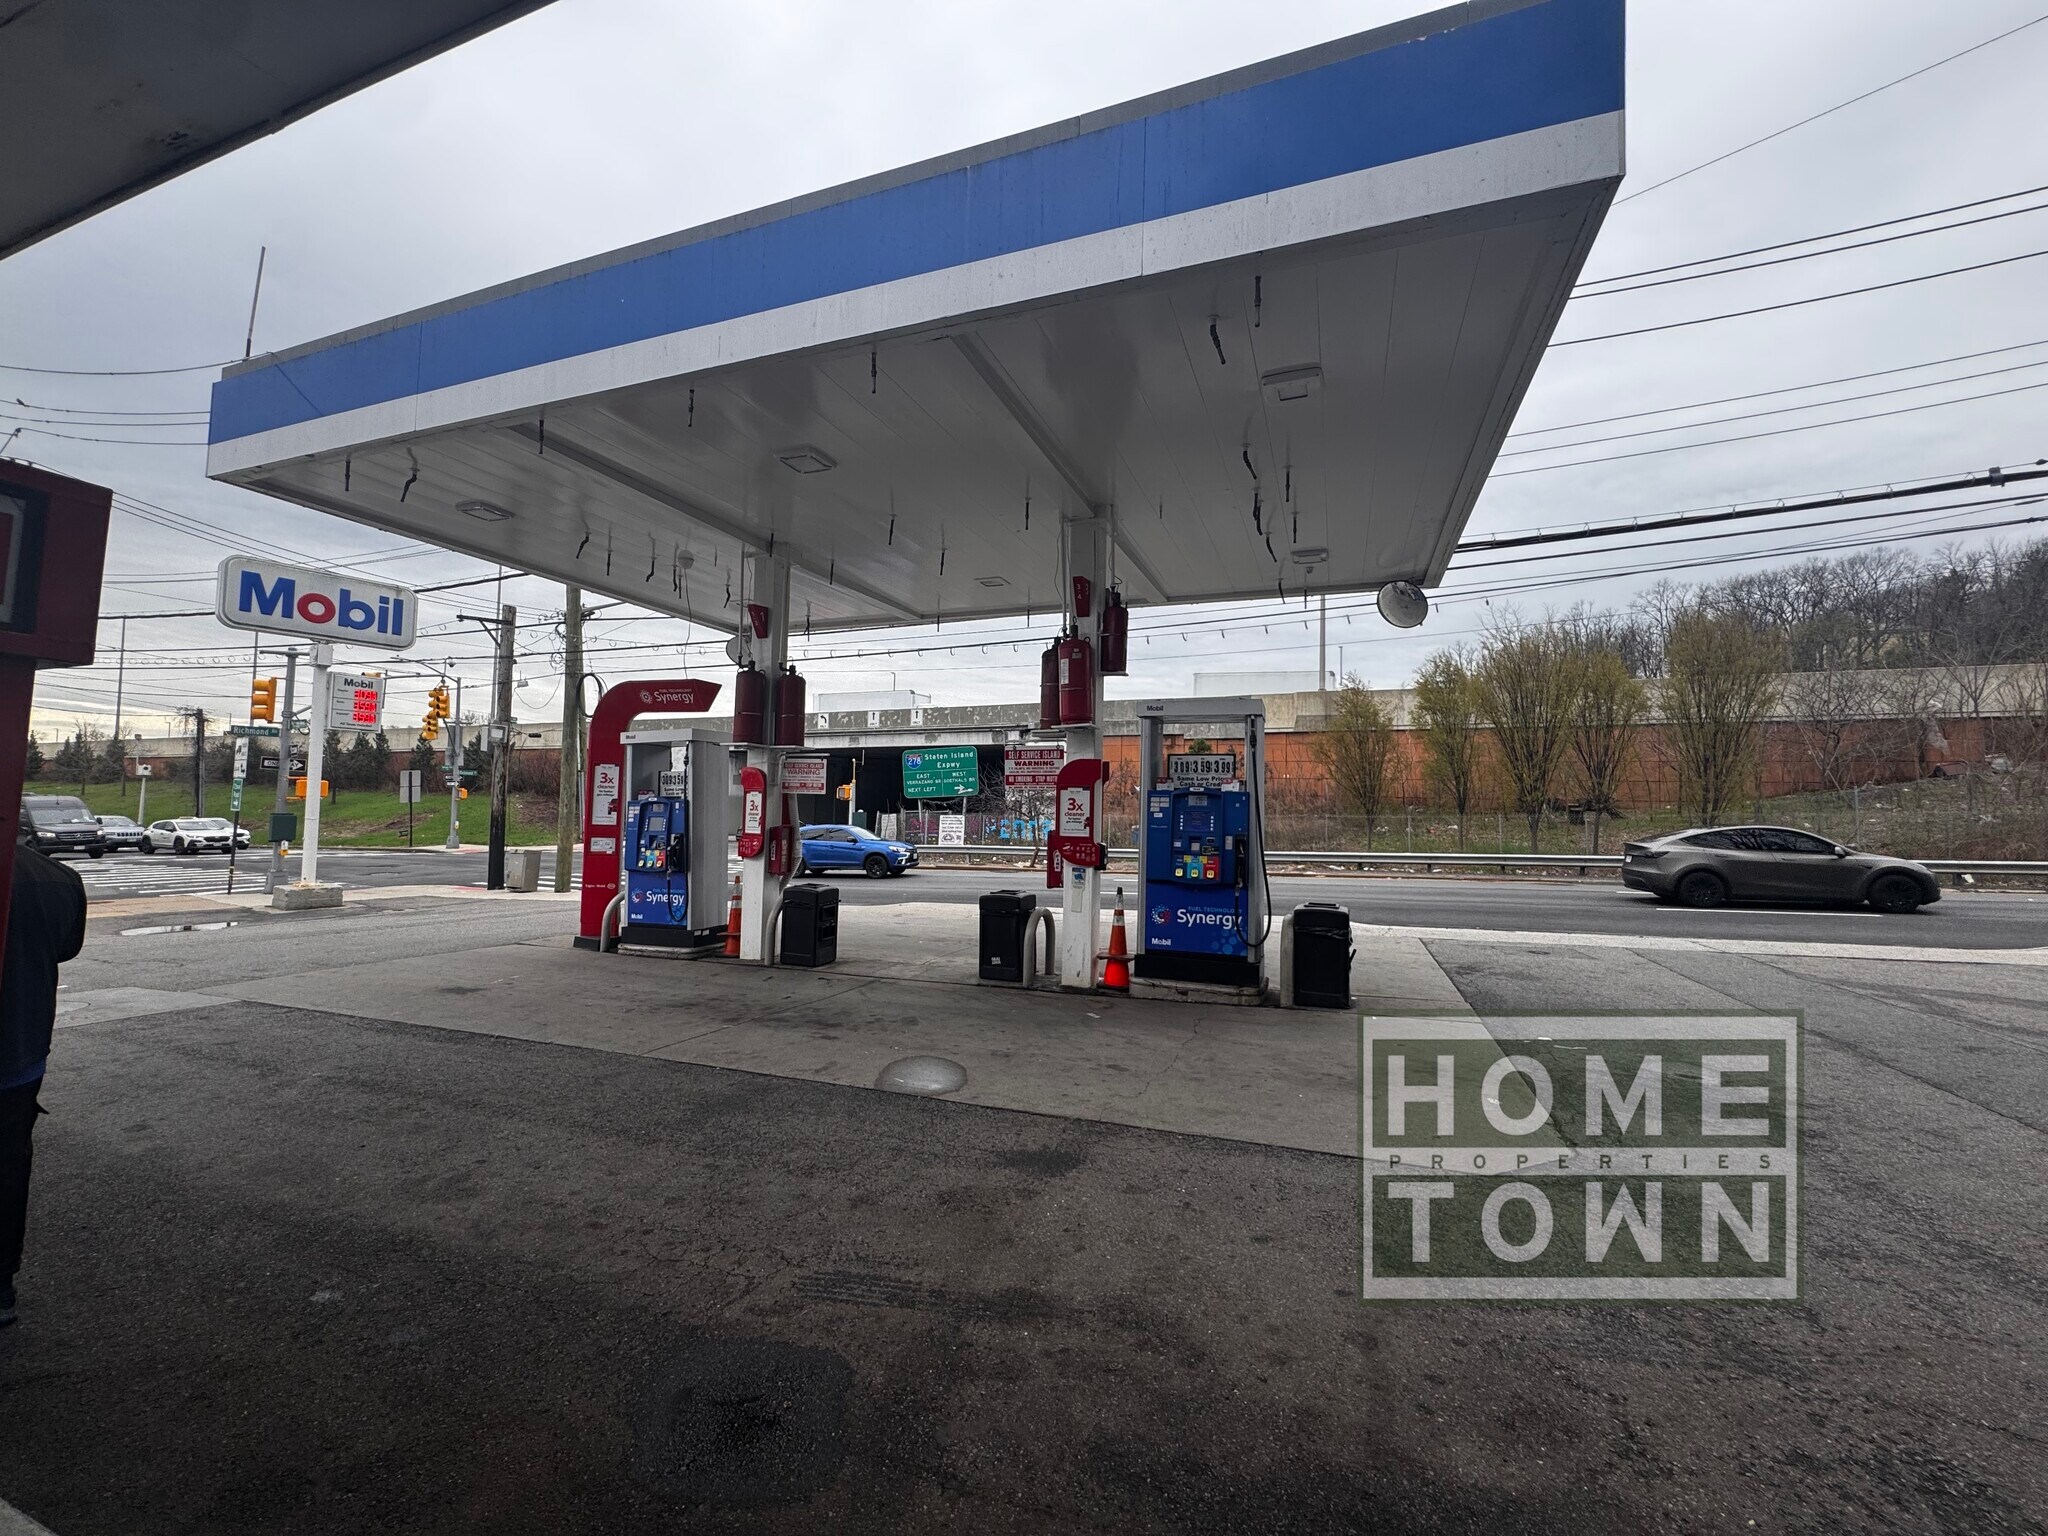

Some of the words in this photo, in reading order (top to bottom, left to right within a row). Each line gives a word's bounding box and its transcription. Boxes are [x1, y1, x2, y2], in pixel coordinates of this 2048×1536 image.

[239, 570, 404, 636] Mobil
[344, 678, 374, 689] Mobil
[654, 691, 694, 704] Synergy
[233, 726, 269, 736] Richmond
[1009, 751, 1019, 759] SELF
[1021, 751, 1041, 759] SERVICE
[1043, 751, 1060, 759] ISLAND
[908, 757, 922, 765] 278
[1174, 761, 1190, 773] 309
[1193, 761, 1211, 773] 359
[1214, 761, 1231, 773] 399
[600, 773, 614, 784] 3x
[750, 800, 759, 811] 3x
[1067, 798, 1083, 811] 3x
[646, 891, 685, 906] Synergy
[1177, 909, 1242, 930] Synergy
[1151, 938, 1171, 946] Mobil
